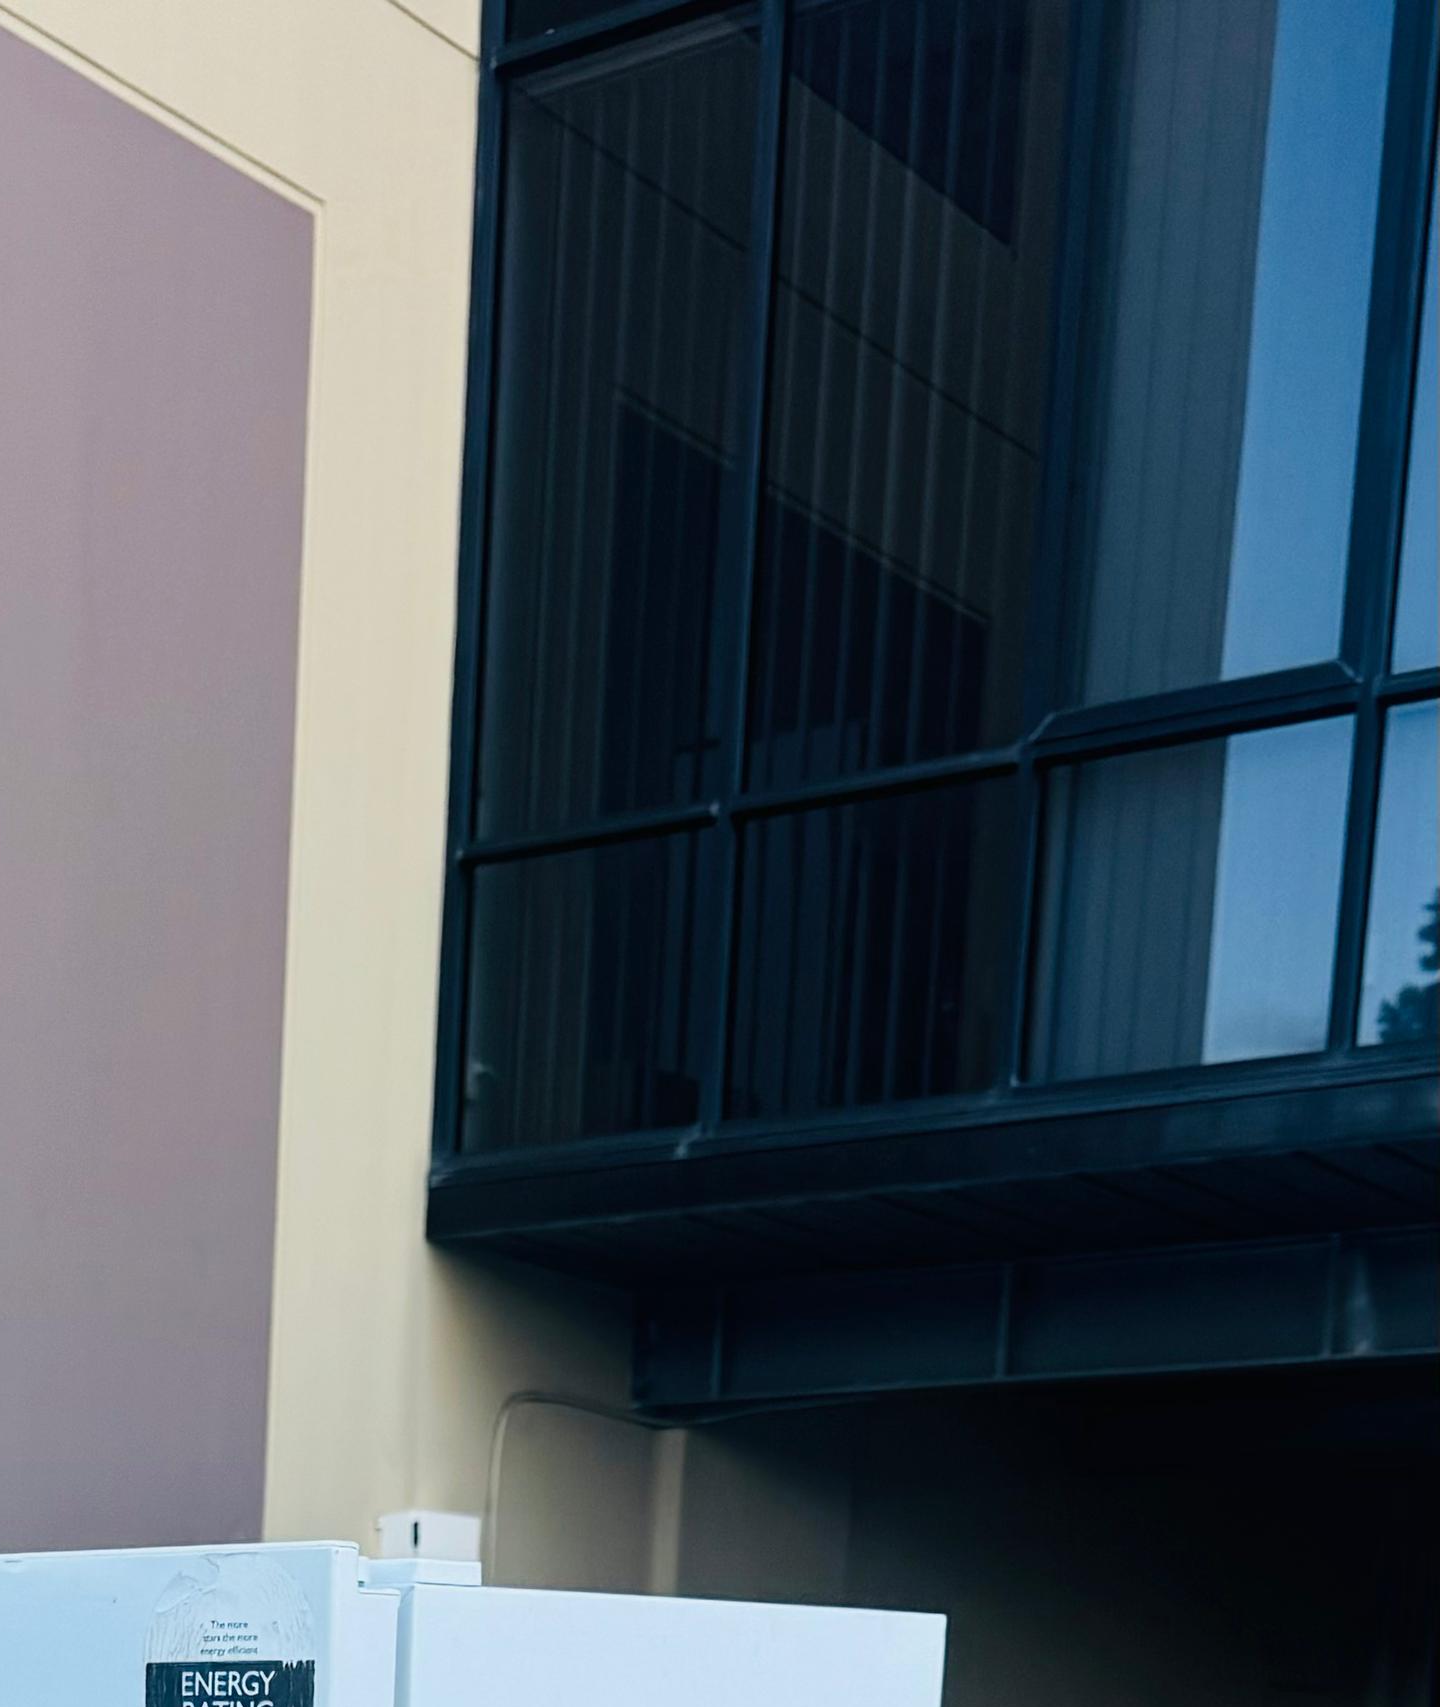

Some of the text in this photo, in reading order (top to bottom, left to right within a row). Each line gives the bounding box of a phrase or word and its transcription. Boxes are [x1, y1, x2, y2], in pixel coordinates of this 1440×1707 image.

[211, 1620, 225, 1629] The
[222, 1632, 236, 1642] the
[200, 1648, 225, 1657] energy
[181, 1670, 275, 1697] ENERGY
